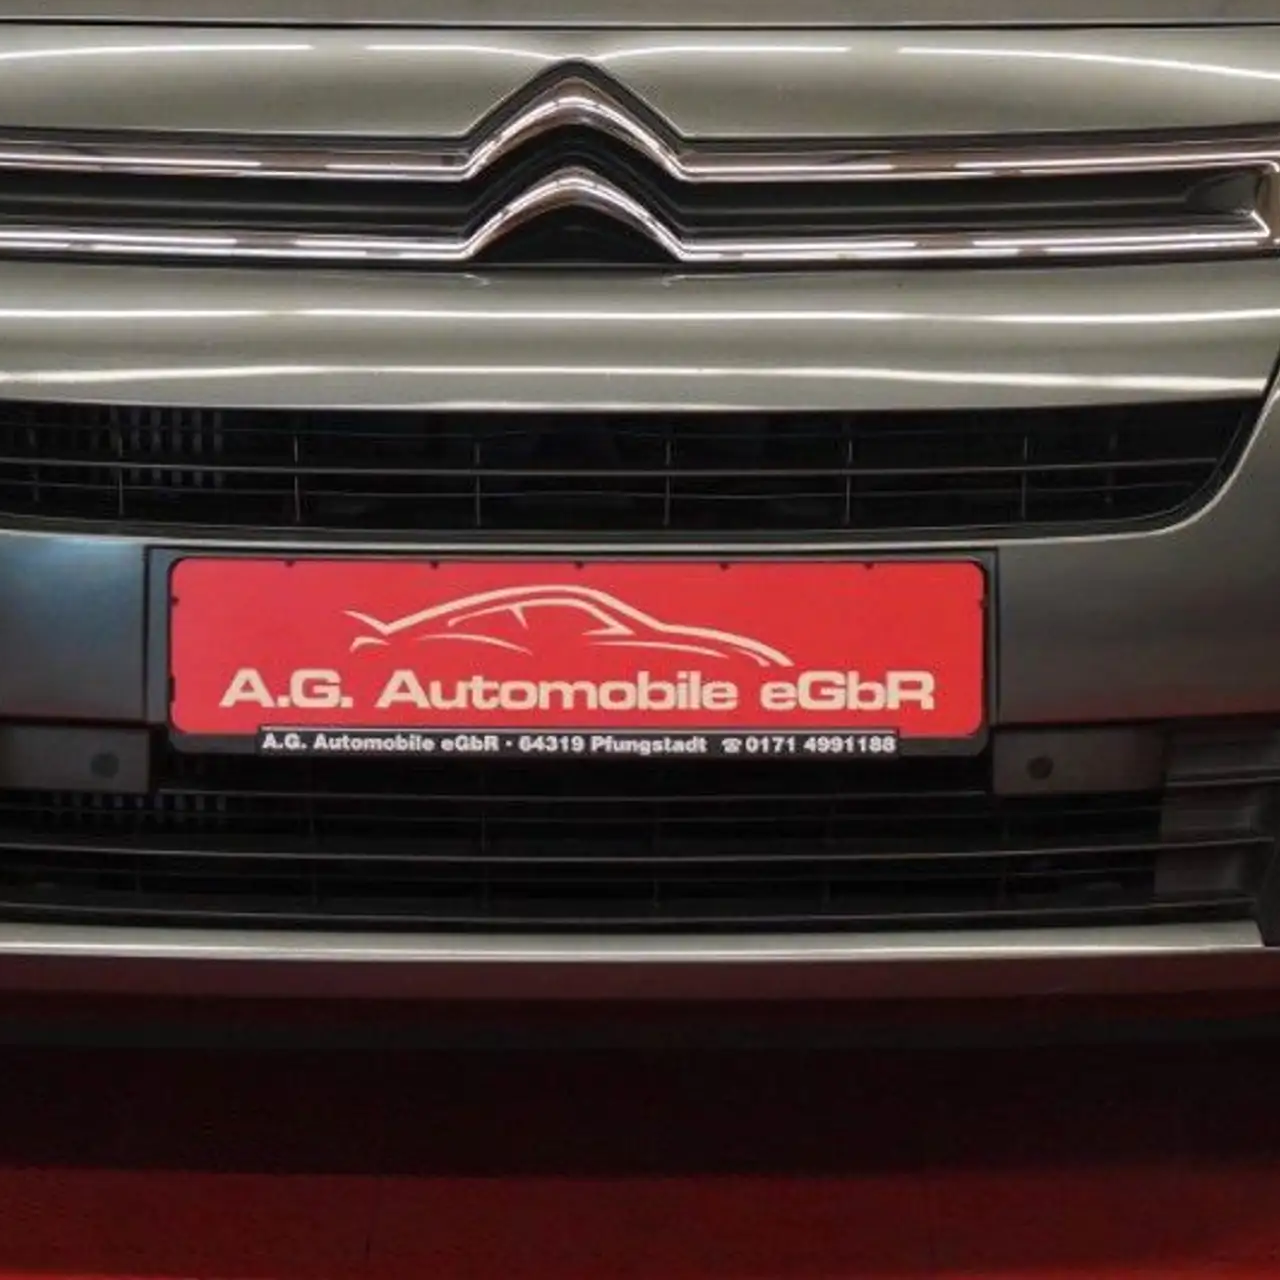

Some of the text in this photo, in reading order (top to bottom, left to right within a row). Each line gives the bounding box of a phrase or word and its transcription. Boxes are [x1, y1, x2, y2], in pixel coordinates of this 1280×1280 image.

[219, 668, 936, 711] A.G. Automobile eGbR
[262, 733, 897, 756] A.G. Automobile eGbR 64319 Pfungstadt 0171 4991188
